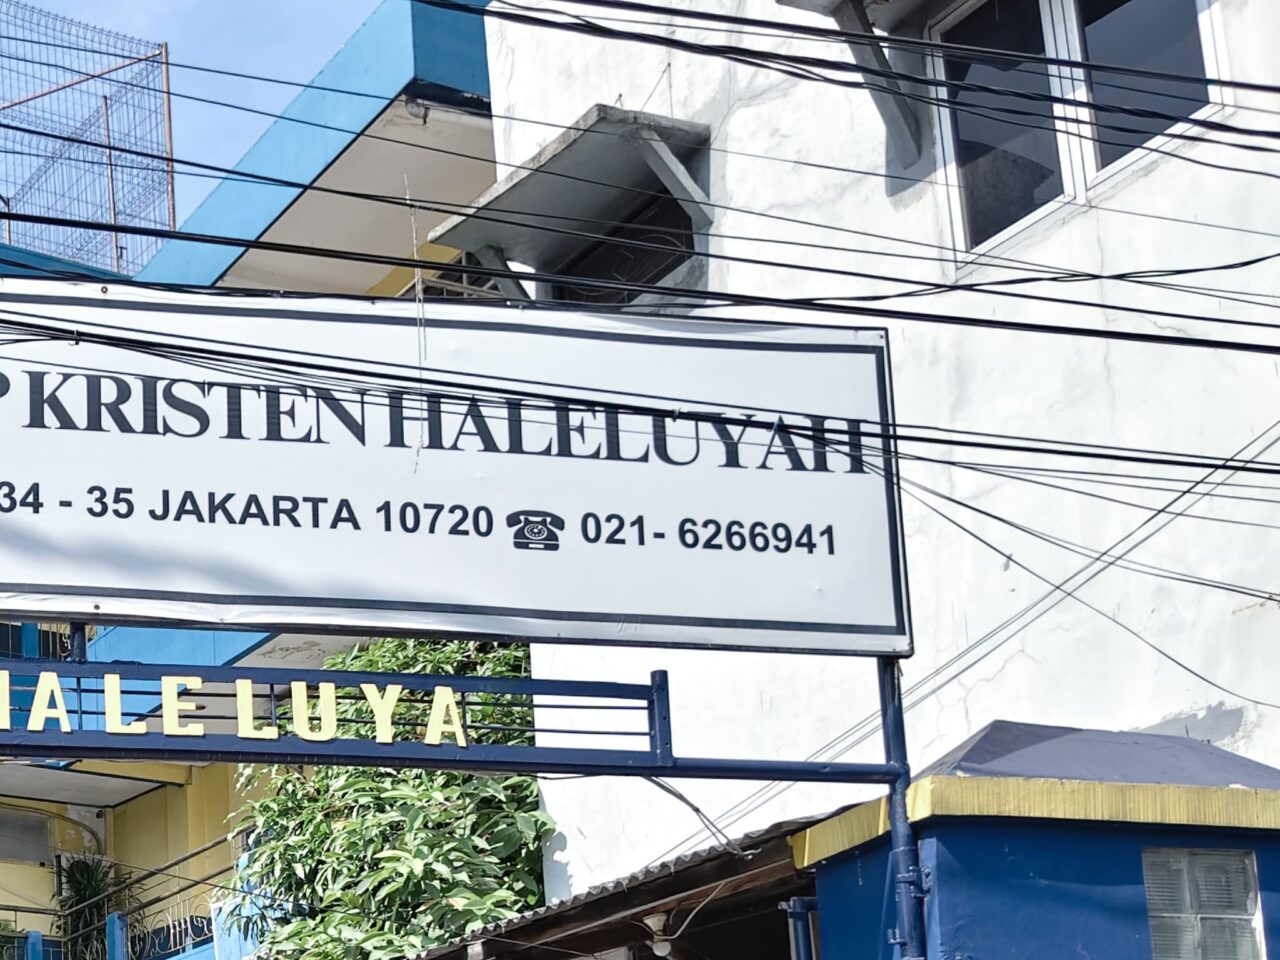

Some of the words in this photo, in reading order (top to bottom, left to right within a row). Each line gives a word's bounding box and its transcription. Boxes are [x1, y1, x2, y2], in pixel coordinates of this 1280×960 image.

[23, 371, 368, 445] KRISTEN
[386, 389, 871, 476] HALELUYAH
[86, 485, 134, 519] 35
[148, 489, 361, 531] JAKARTA
[376, 500, 494, 538] 10720
[678, 517, 835, 555] 6266941
